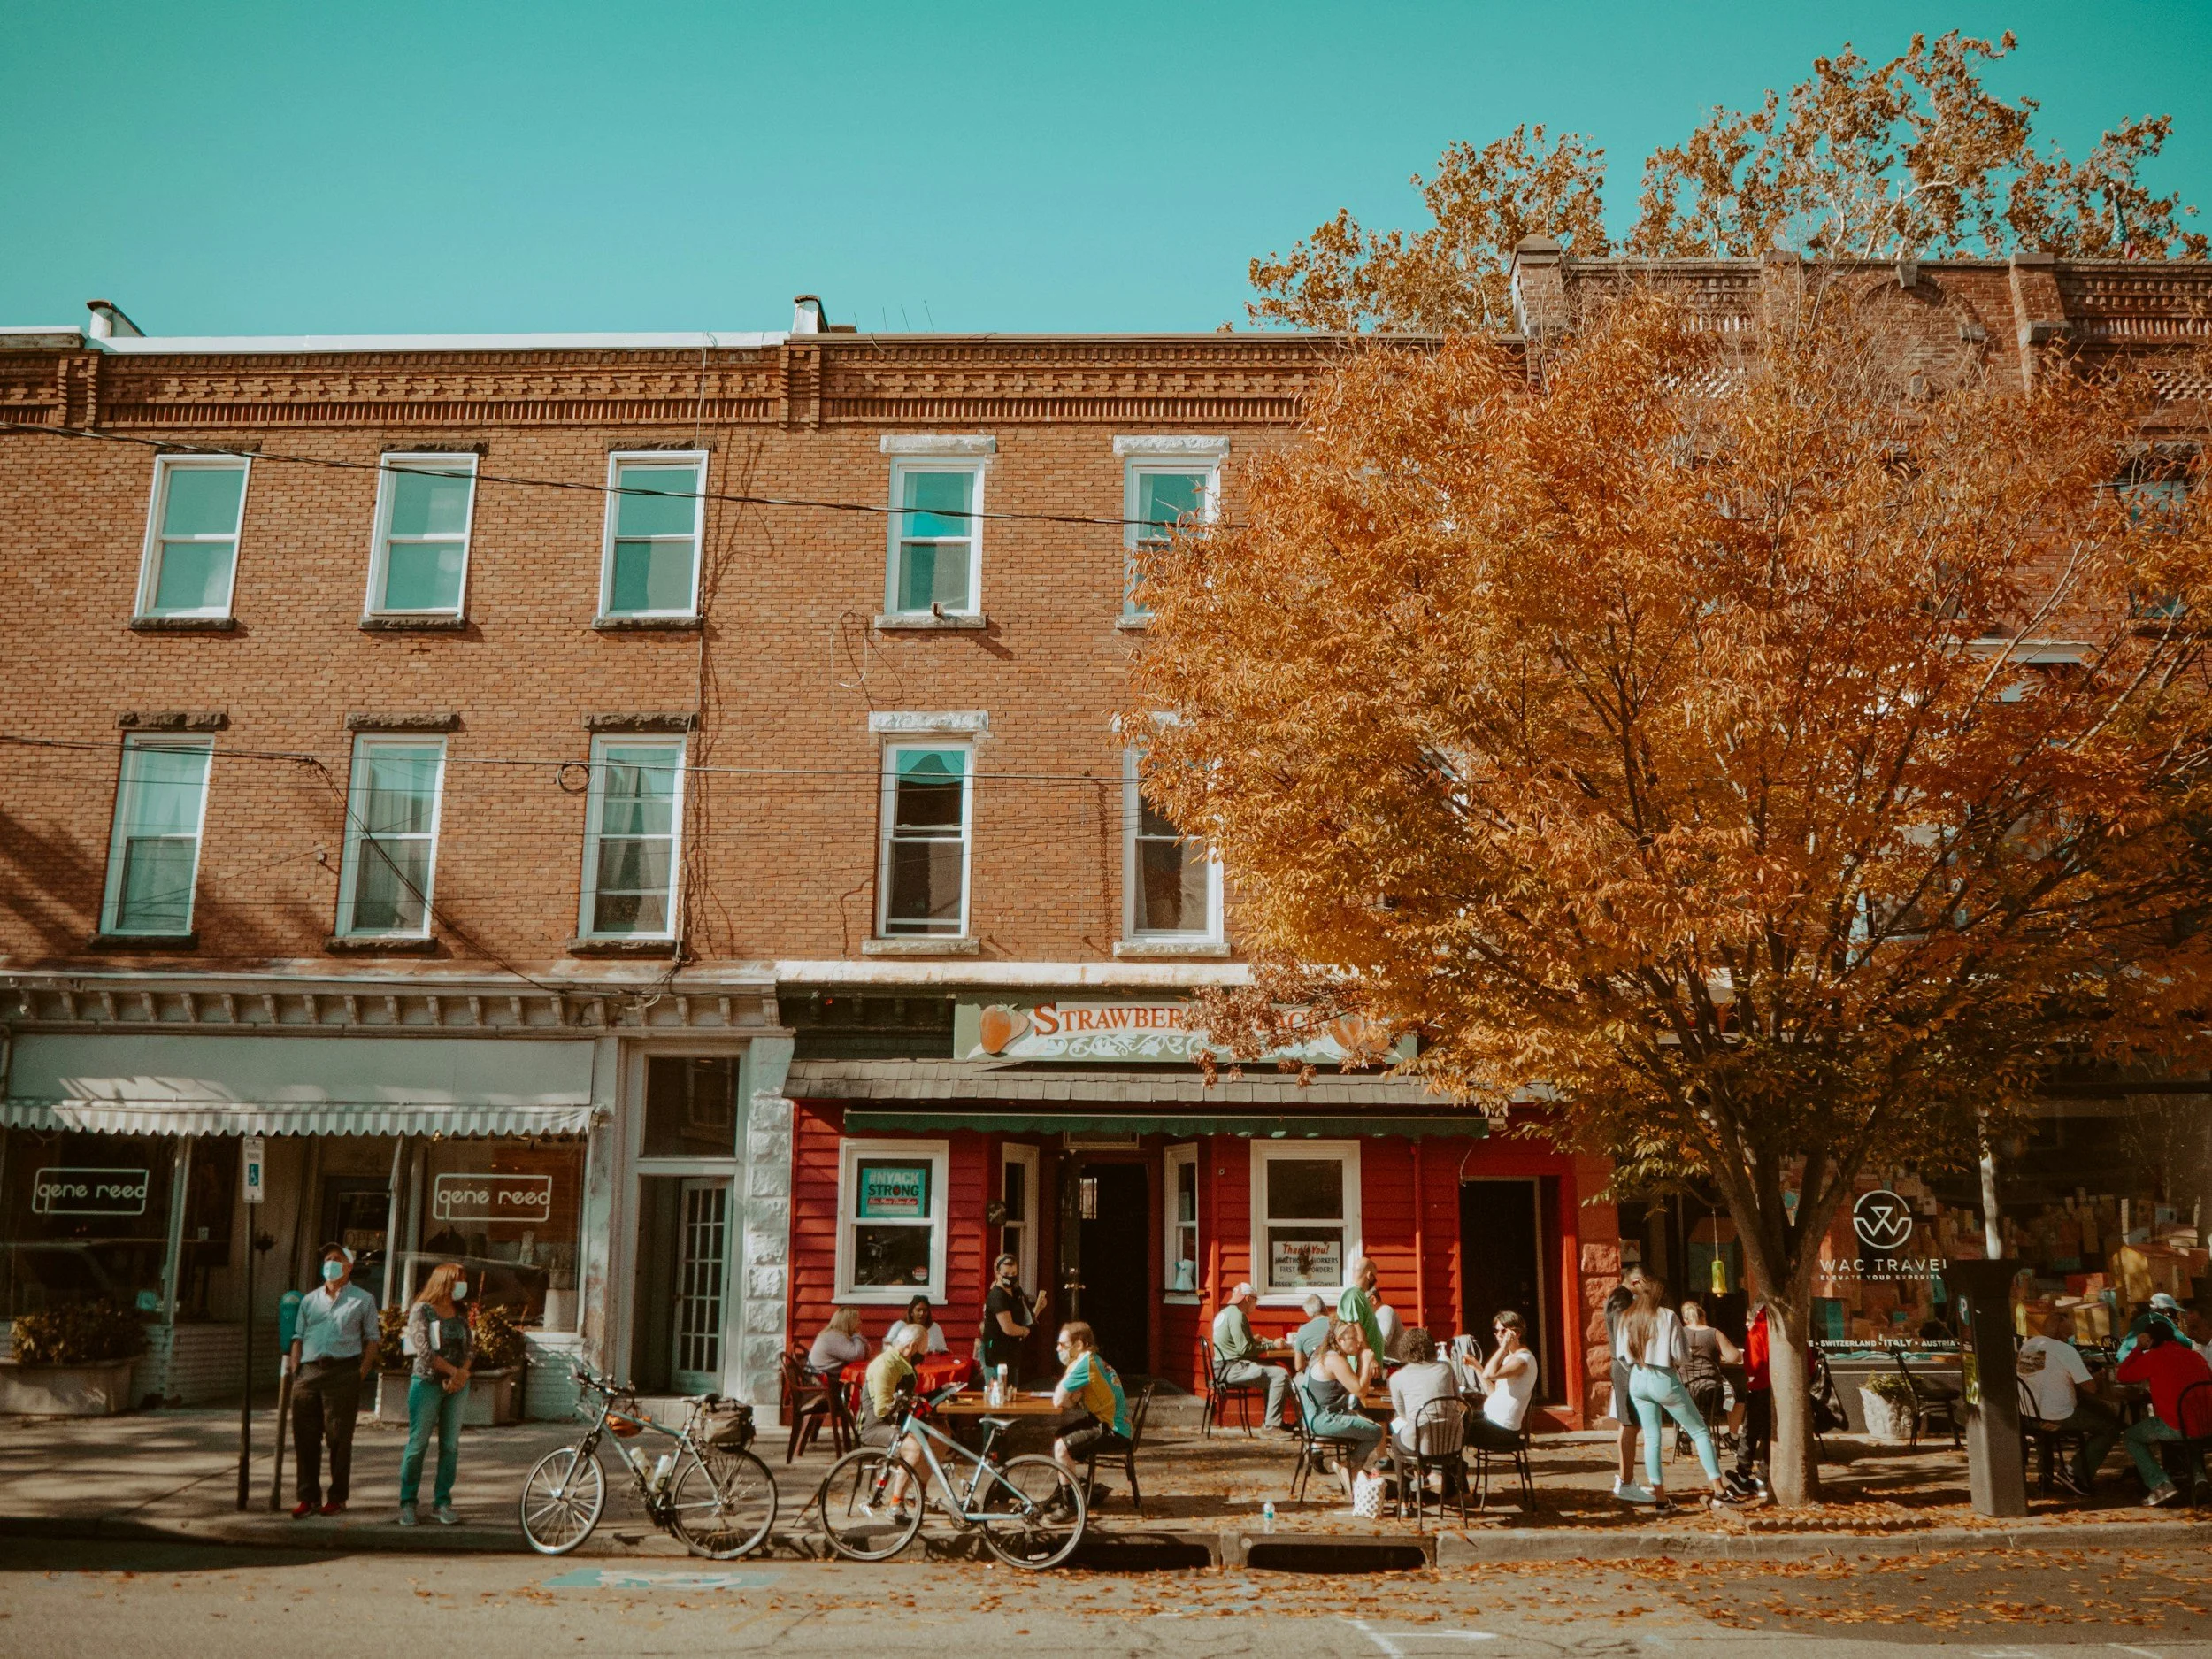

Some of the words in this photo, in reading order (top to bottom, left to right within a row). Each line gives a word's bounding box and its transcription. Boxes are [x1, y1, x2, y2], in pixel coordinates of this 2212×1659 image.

[1033, 1002, 1196, 1036] STRAWBER
[96, 1175, 148, 1199] reed
[498, 1180, 552, 1205] reed
[868, 1184, 919, 1196] STRONG
[1820, 1259, 1864, 1271] WAC
